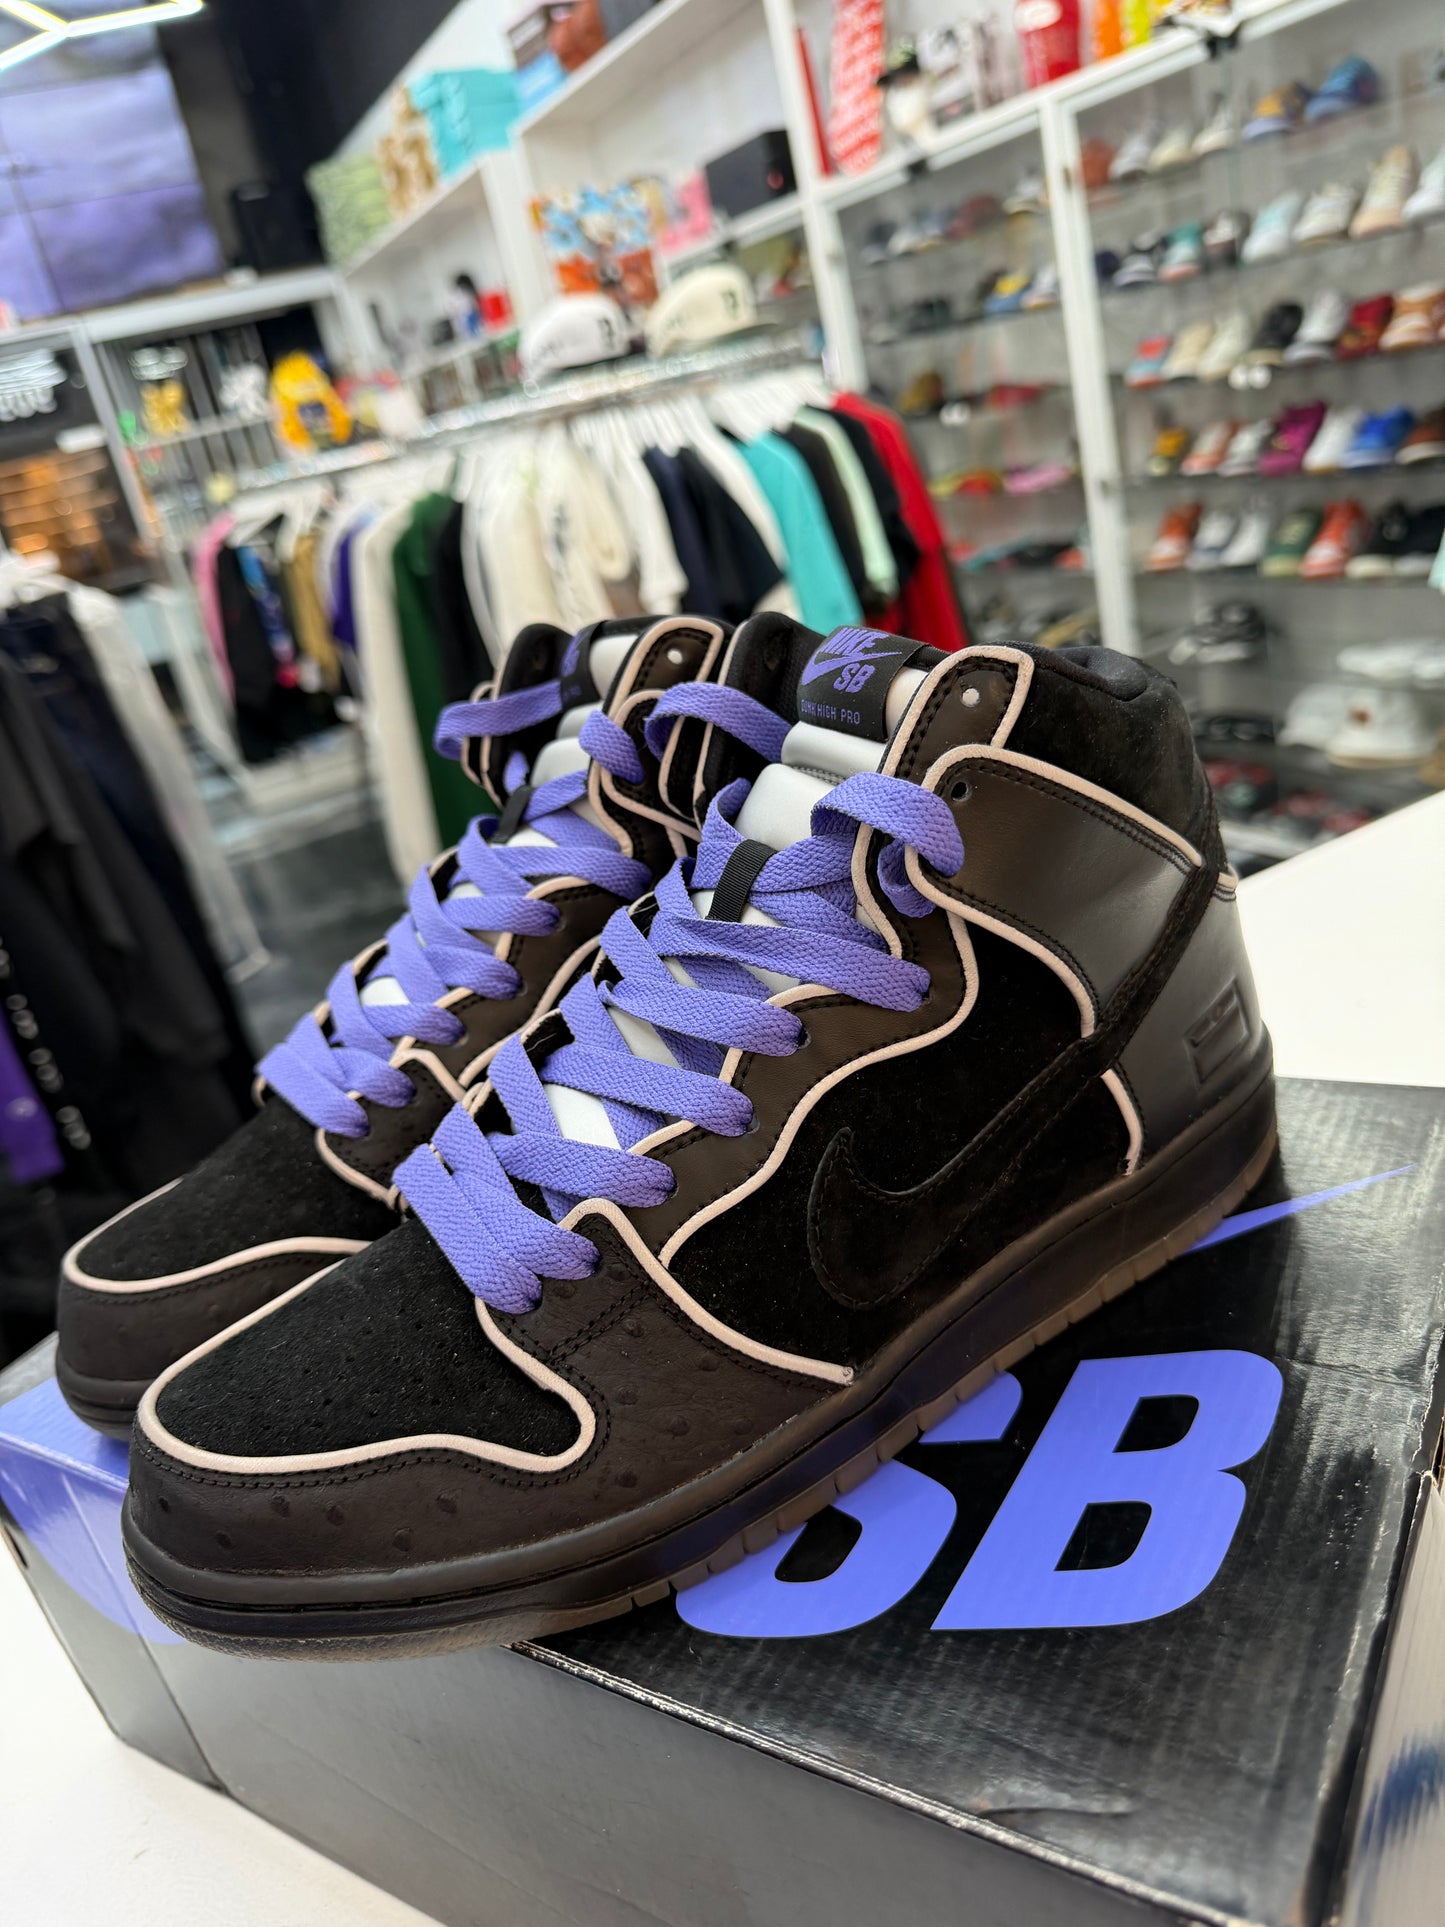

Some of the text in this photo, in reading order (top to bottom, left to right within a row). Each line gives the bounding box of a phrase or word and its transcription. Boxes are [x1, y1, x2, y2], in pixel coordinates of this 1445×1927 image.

[818, 627, 890, 657] NIKE
[833, 662, 876, 693] SB
[817, 704, 837, 720] HIGH
[840, 708, 861, 725] PRO
